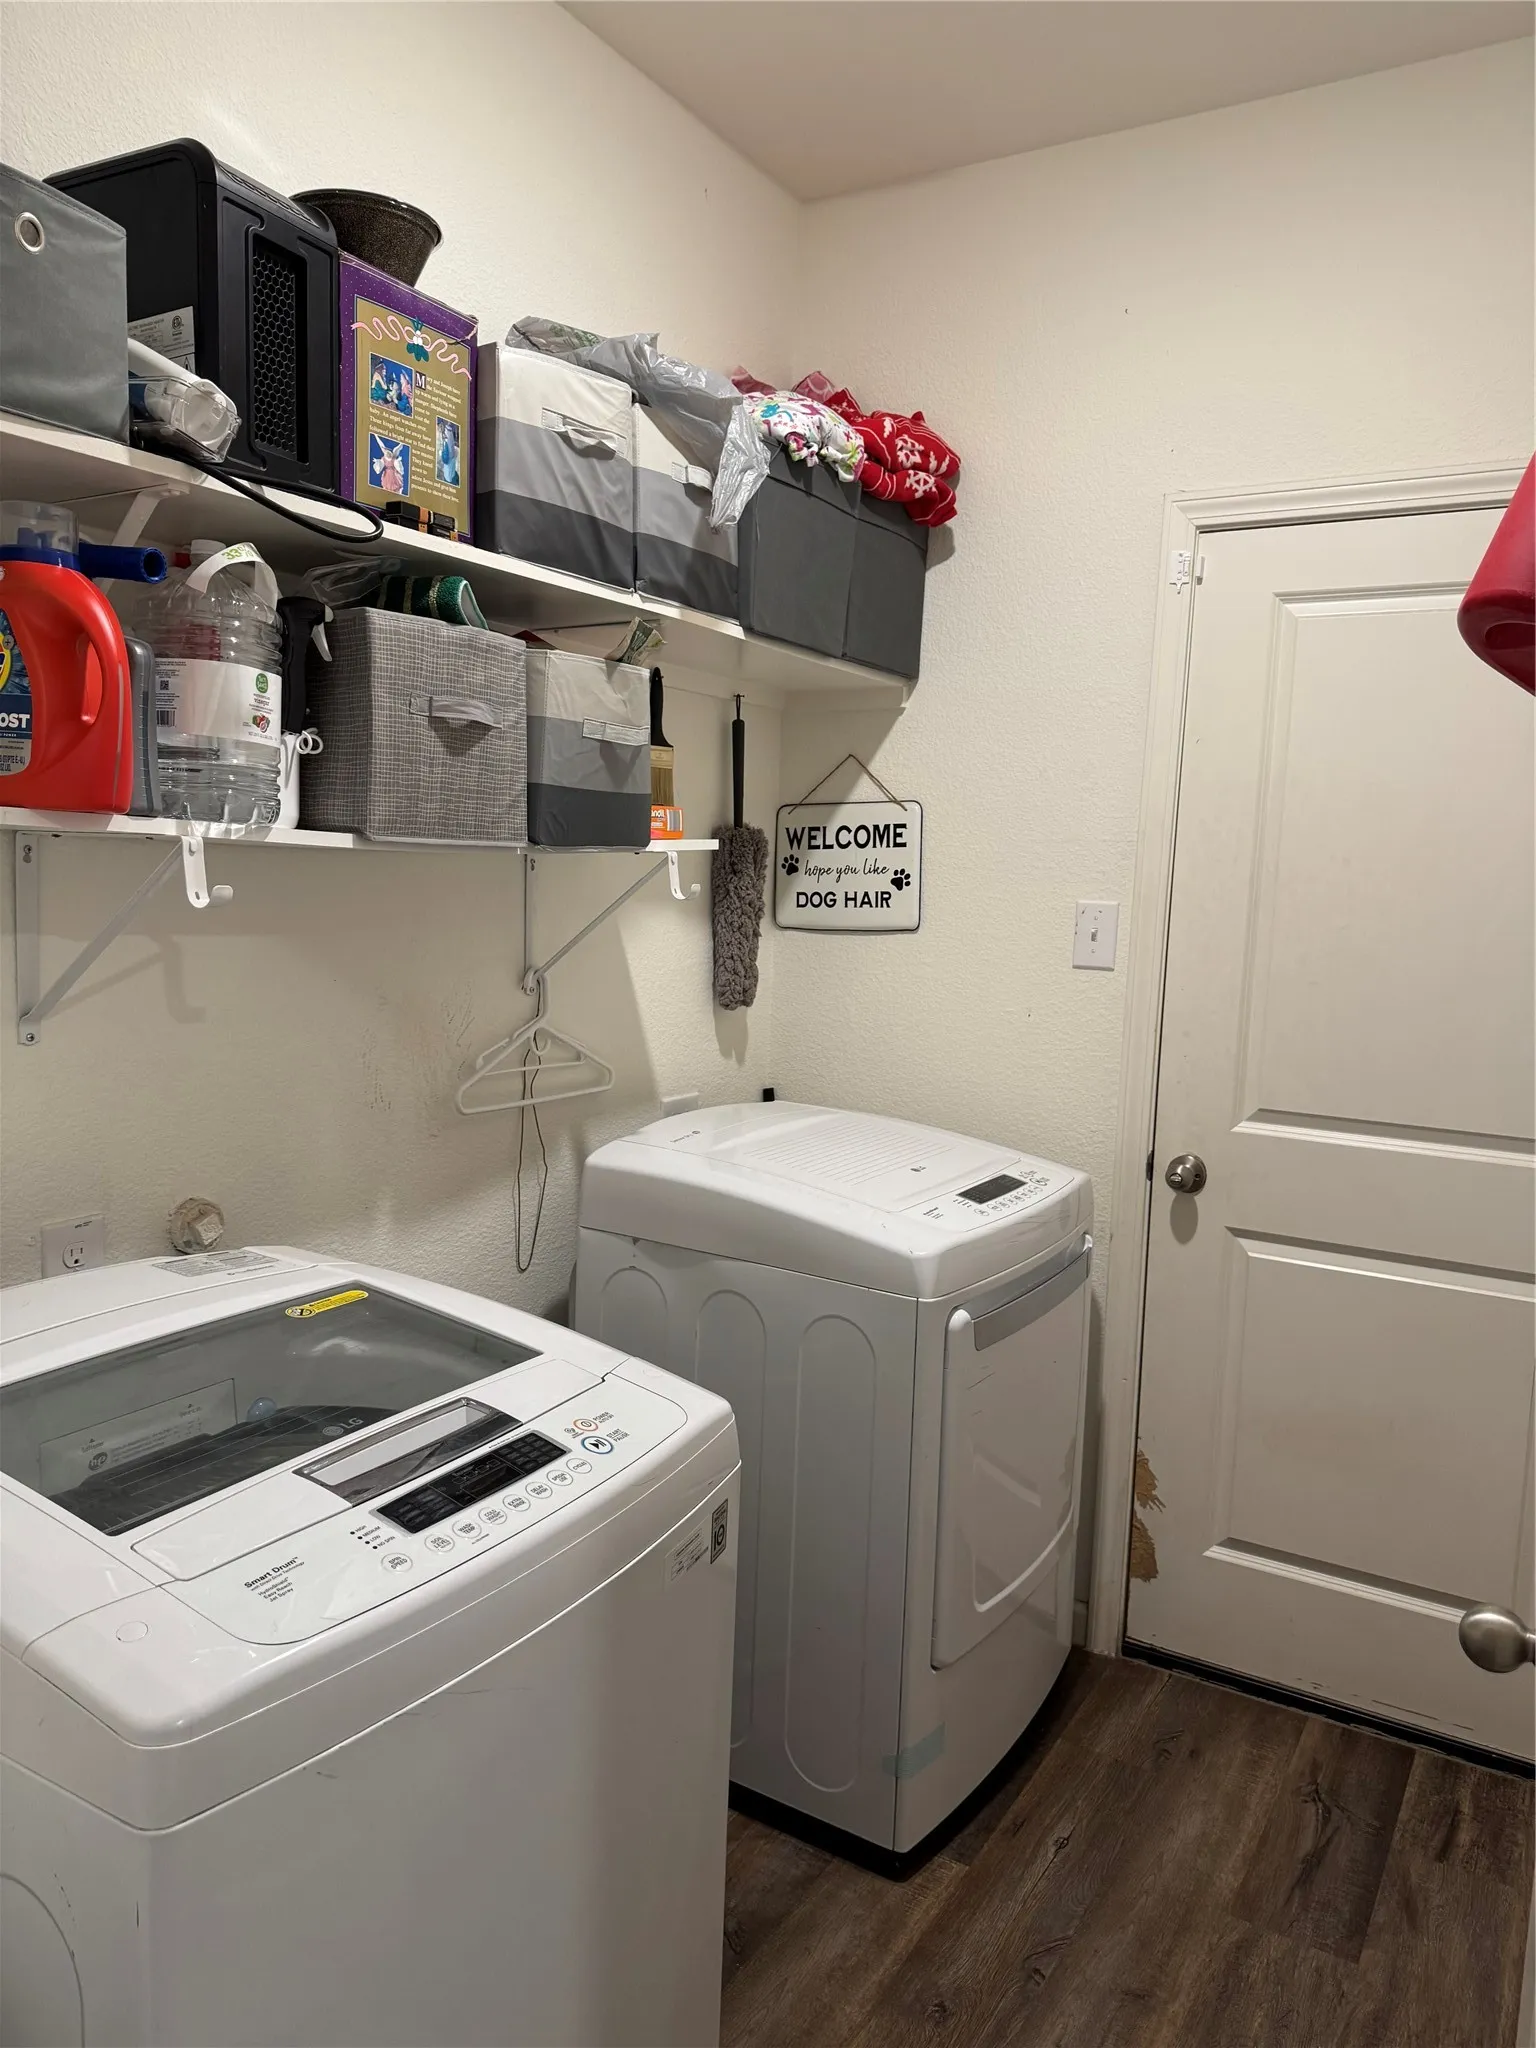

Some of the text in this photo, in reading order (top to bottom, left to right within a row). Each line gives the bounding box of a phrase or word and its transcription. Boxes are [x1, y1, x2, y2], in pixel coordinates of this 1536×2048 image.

[0, 712, 30, 728] OST
[785, 823, 908, 850] WELCOME
[804, 858, 890, 883] hope you like
[796, 891, 892, 908] DOG HAIR
[338, 1418, 364, 1428] LG
[606, 1428, 622, 1438] START
[613, 1432, 630, 1442] PAUSE
[530, 1484, 544, 1492] DELAY
[508, 1497, 522, 1506] EXTRA
[362, 1526, 380, 1537] MEDIUM
[458, 1523, 472, 1532] WASH
[463, 1526, 476, 1534] TEMP
[388, 1556, 402, 1564] SPIN
[390, 1558, 408, 1570] SPEED
[244, 1572, 272, 1588] Smart
[263, 1591, 276, 1599] Easy
[278, 1588, 294, 1597] Spray
